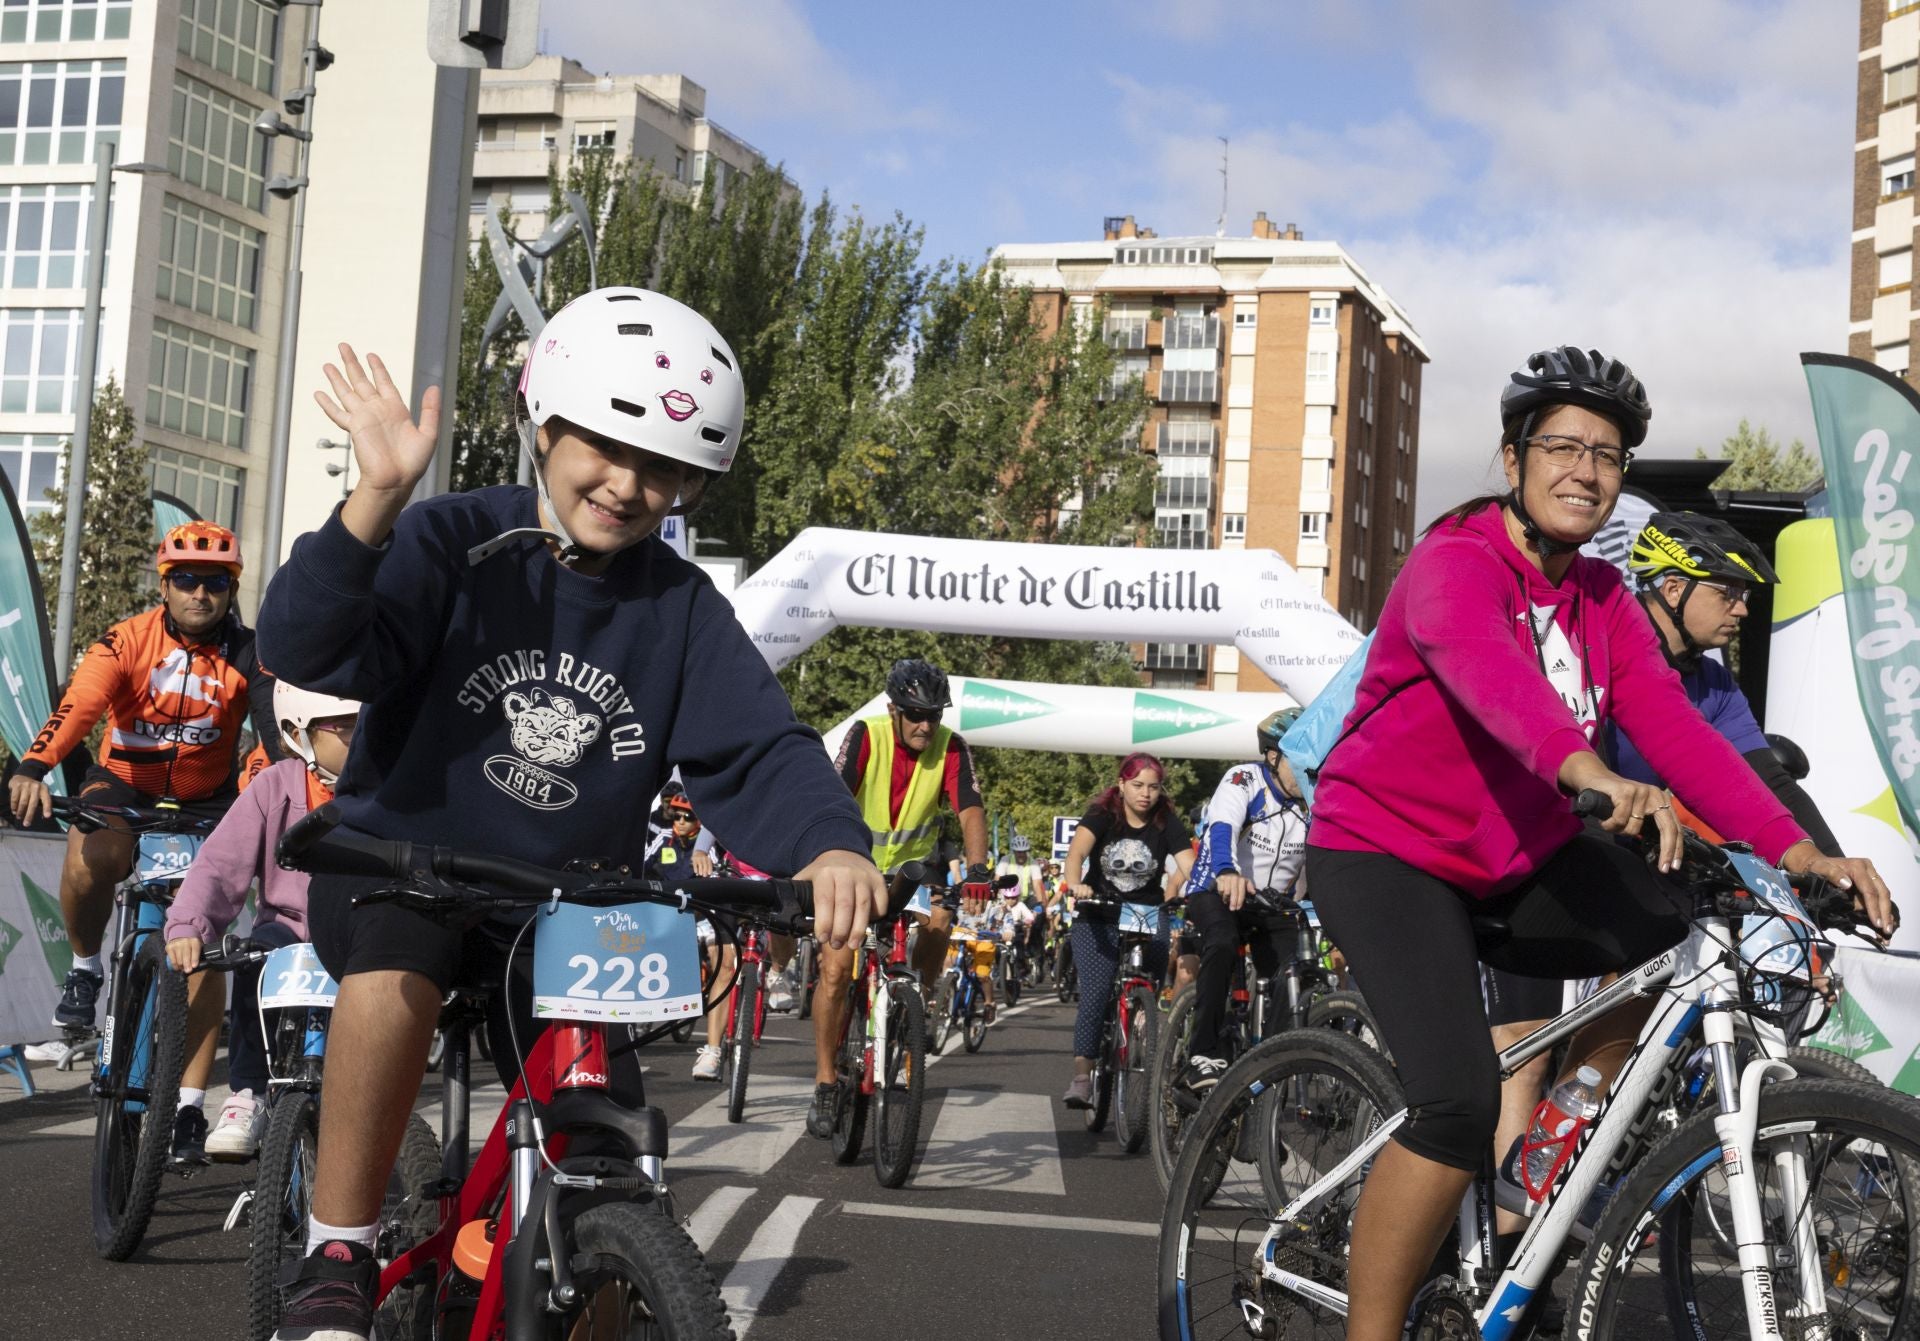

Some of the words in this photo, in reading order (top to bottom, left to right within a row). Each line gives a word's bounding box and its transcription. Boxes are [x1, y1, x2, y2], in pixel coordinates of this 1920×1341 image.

[846, 553, 896, 597] El
[906, 556, 1010, 602] Norte
[1017, 565, 1057, 607] de
[1064, 566, 1223, 612] Castilla
[1243, 627, 1280, 638] Castilla
[1278, 655, 1302, 666] Norte
[457, 650, 546, 714] STRONG
[555, 652, 635, 722] RUGBY
[610, 723, 646, 761] CO.
[31, 704, 74, 754] IVECO
[133, 719, 221, 746] IVECO
[505, 766, 552, 804] 1984
[152, 851, 191, 871] 230
[276, 970, 330, 996] 227
[567, 953, 670, 1000] 228
[1667, 1175, 1685, 1197] 9800
[1616, 1211, 1656, 1273] XCR
[1686, 1302, 1697, 1317] DT
